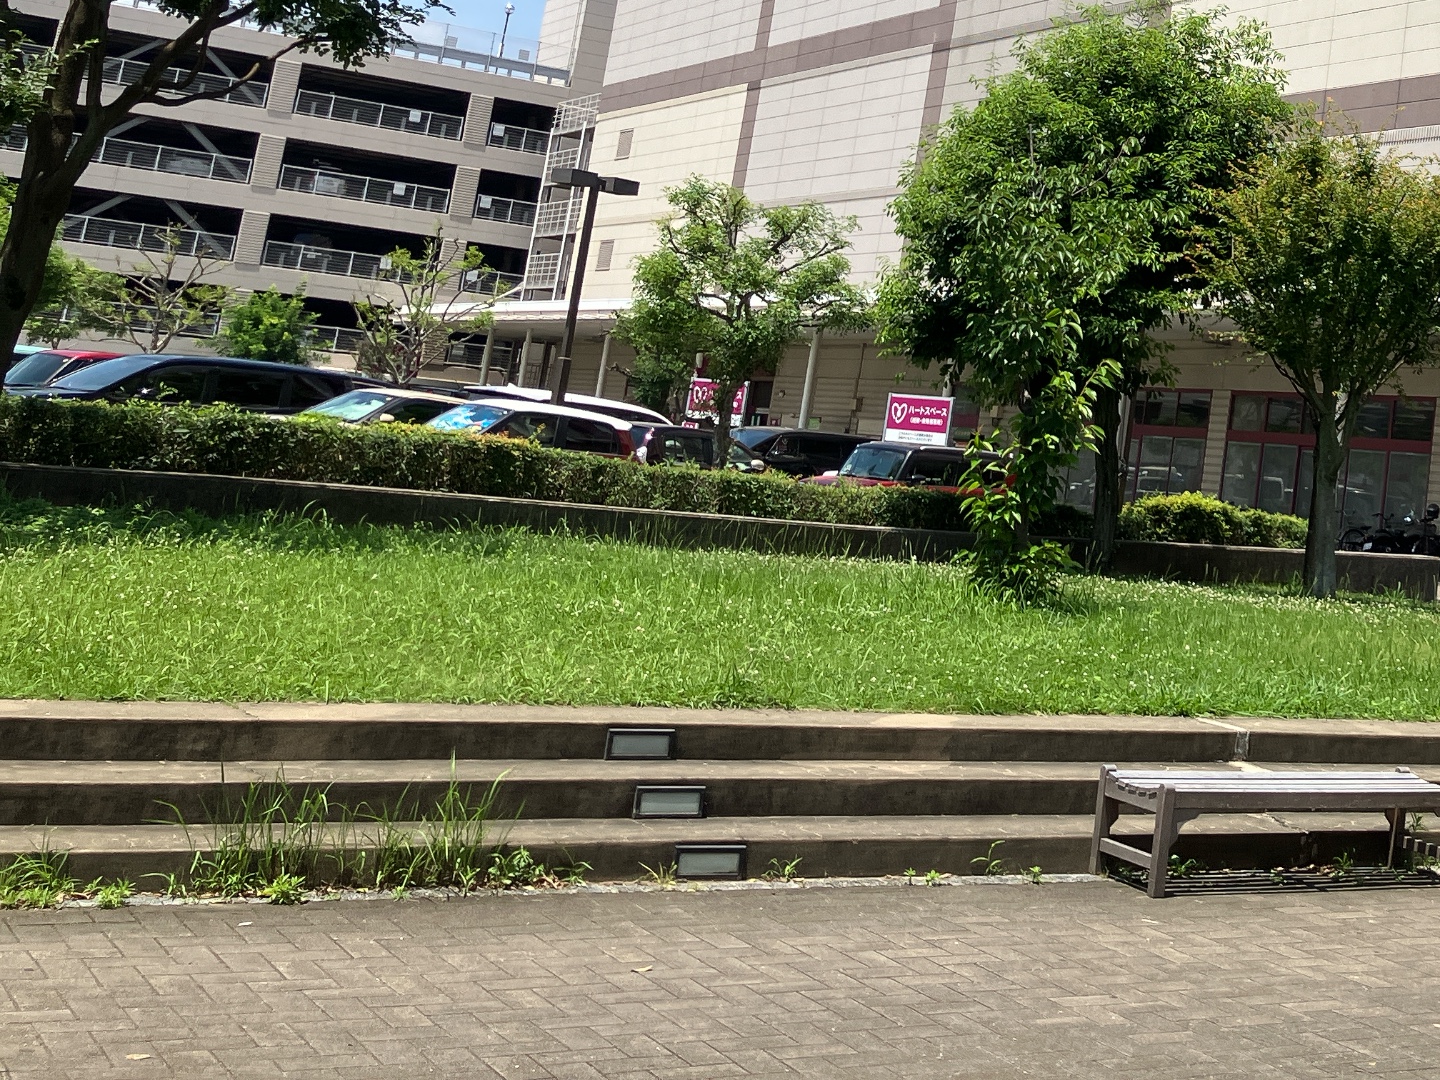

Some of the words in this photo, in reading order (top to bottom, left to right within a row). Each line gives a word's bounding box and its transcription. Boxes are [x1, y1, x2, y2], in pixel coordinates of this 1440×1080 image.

[908, 405, 948, 417] ハートスペース
